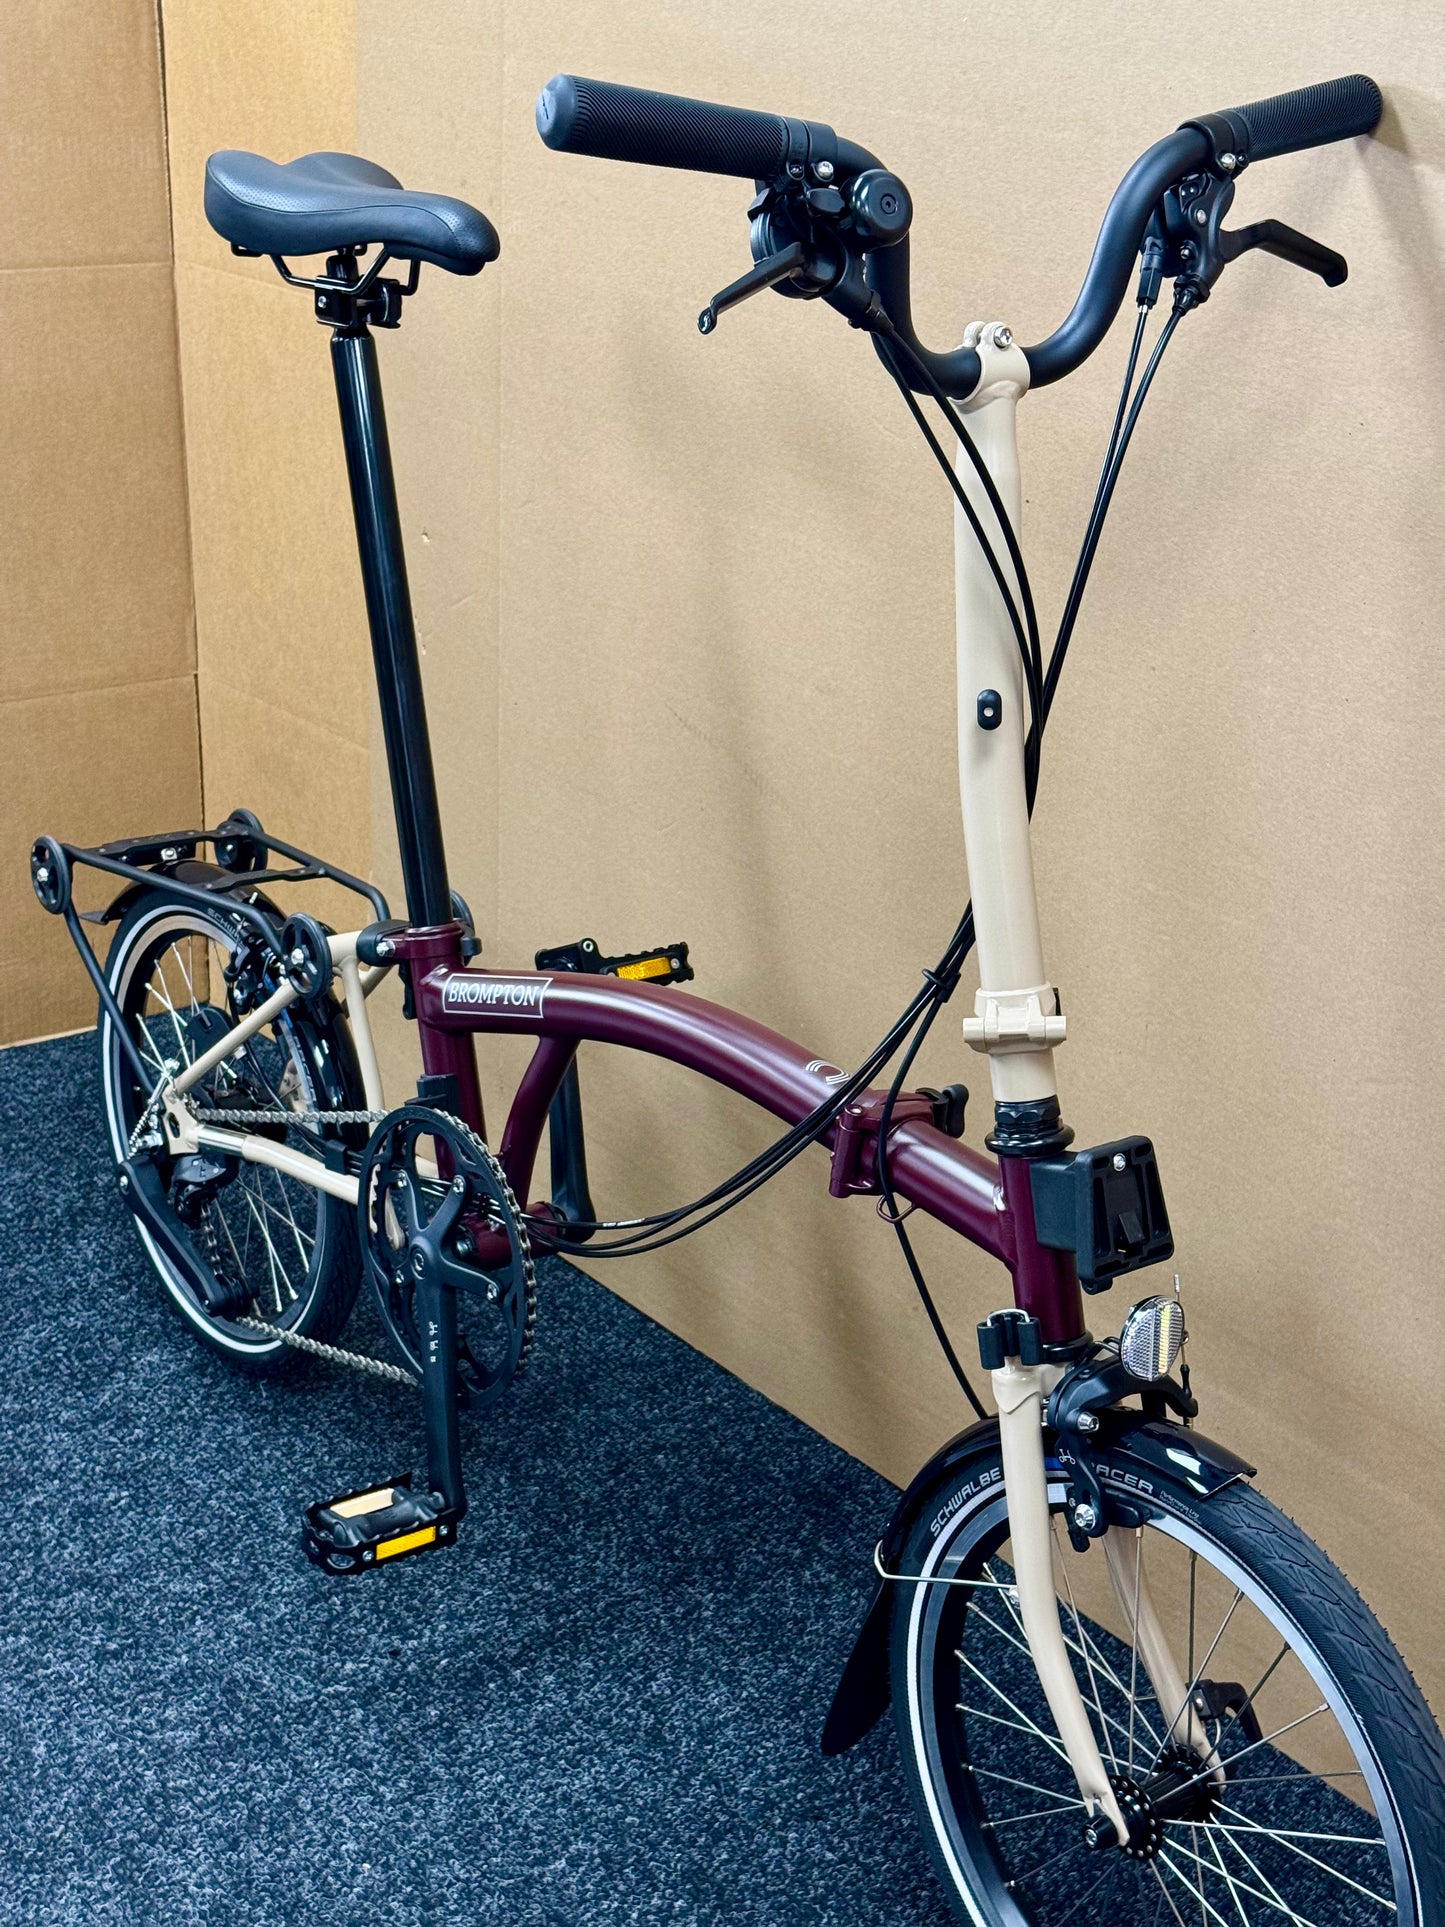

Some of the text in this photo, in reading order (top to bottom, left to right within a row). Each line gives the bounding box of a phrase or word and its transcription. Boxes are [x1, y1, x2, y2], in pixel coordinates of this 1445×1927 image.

[448, 982, 539, 1006] BROMPTON
[930, 1462, 1154, 1537] SCHWALBE ACER
